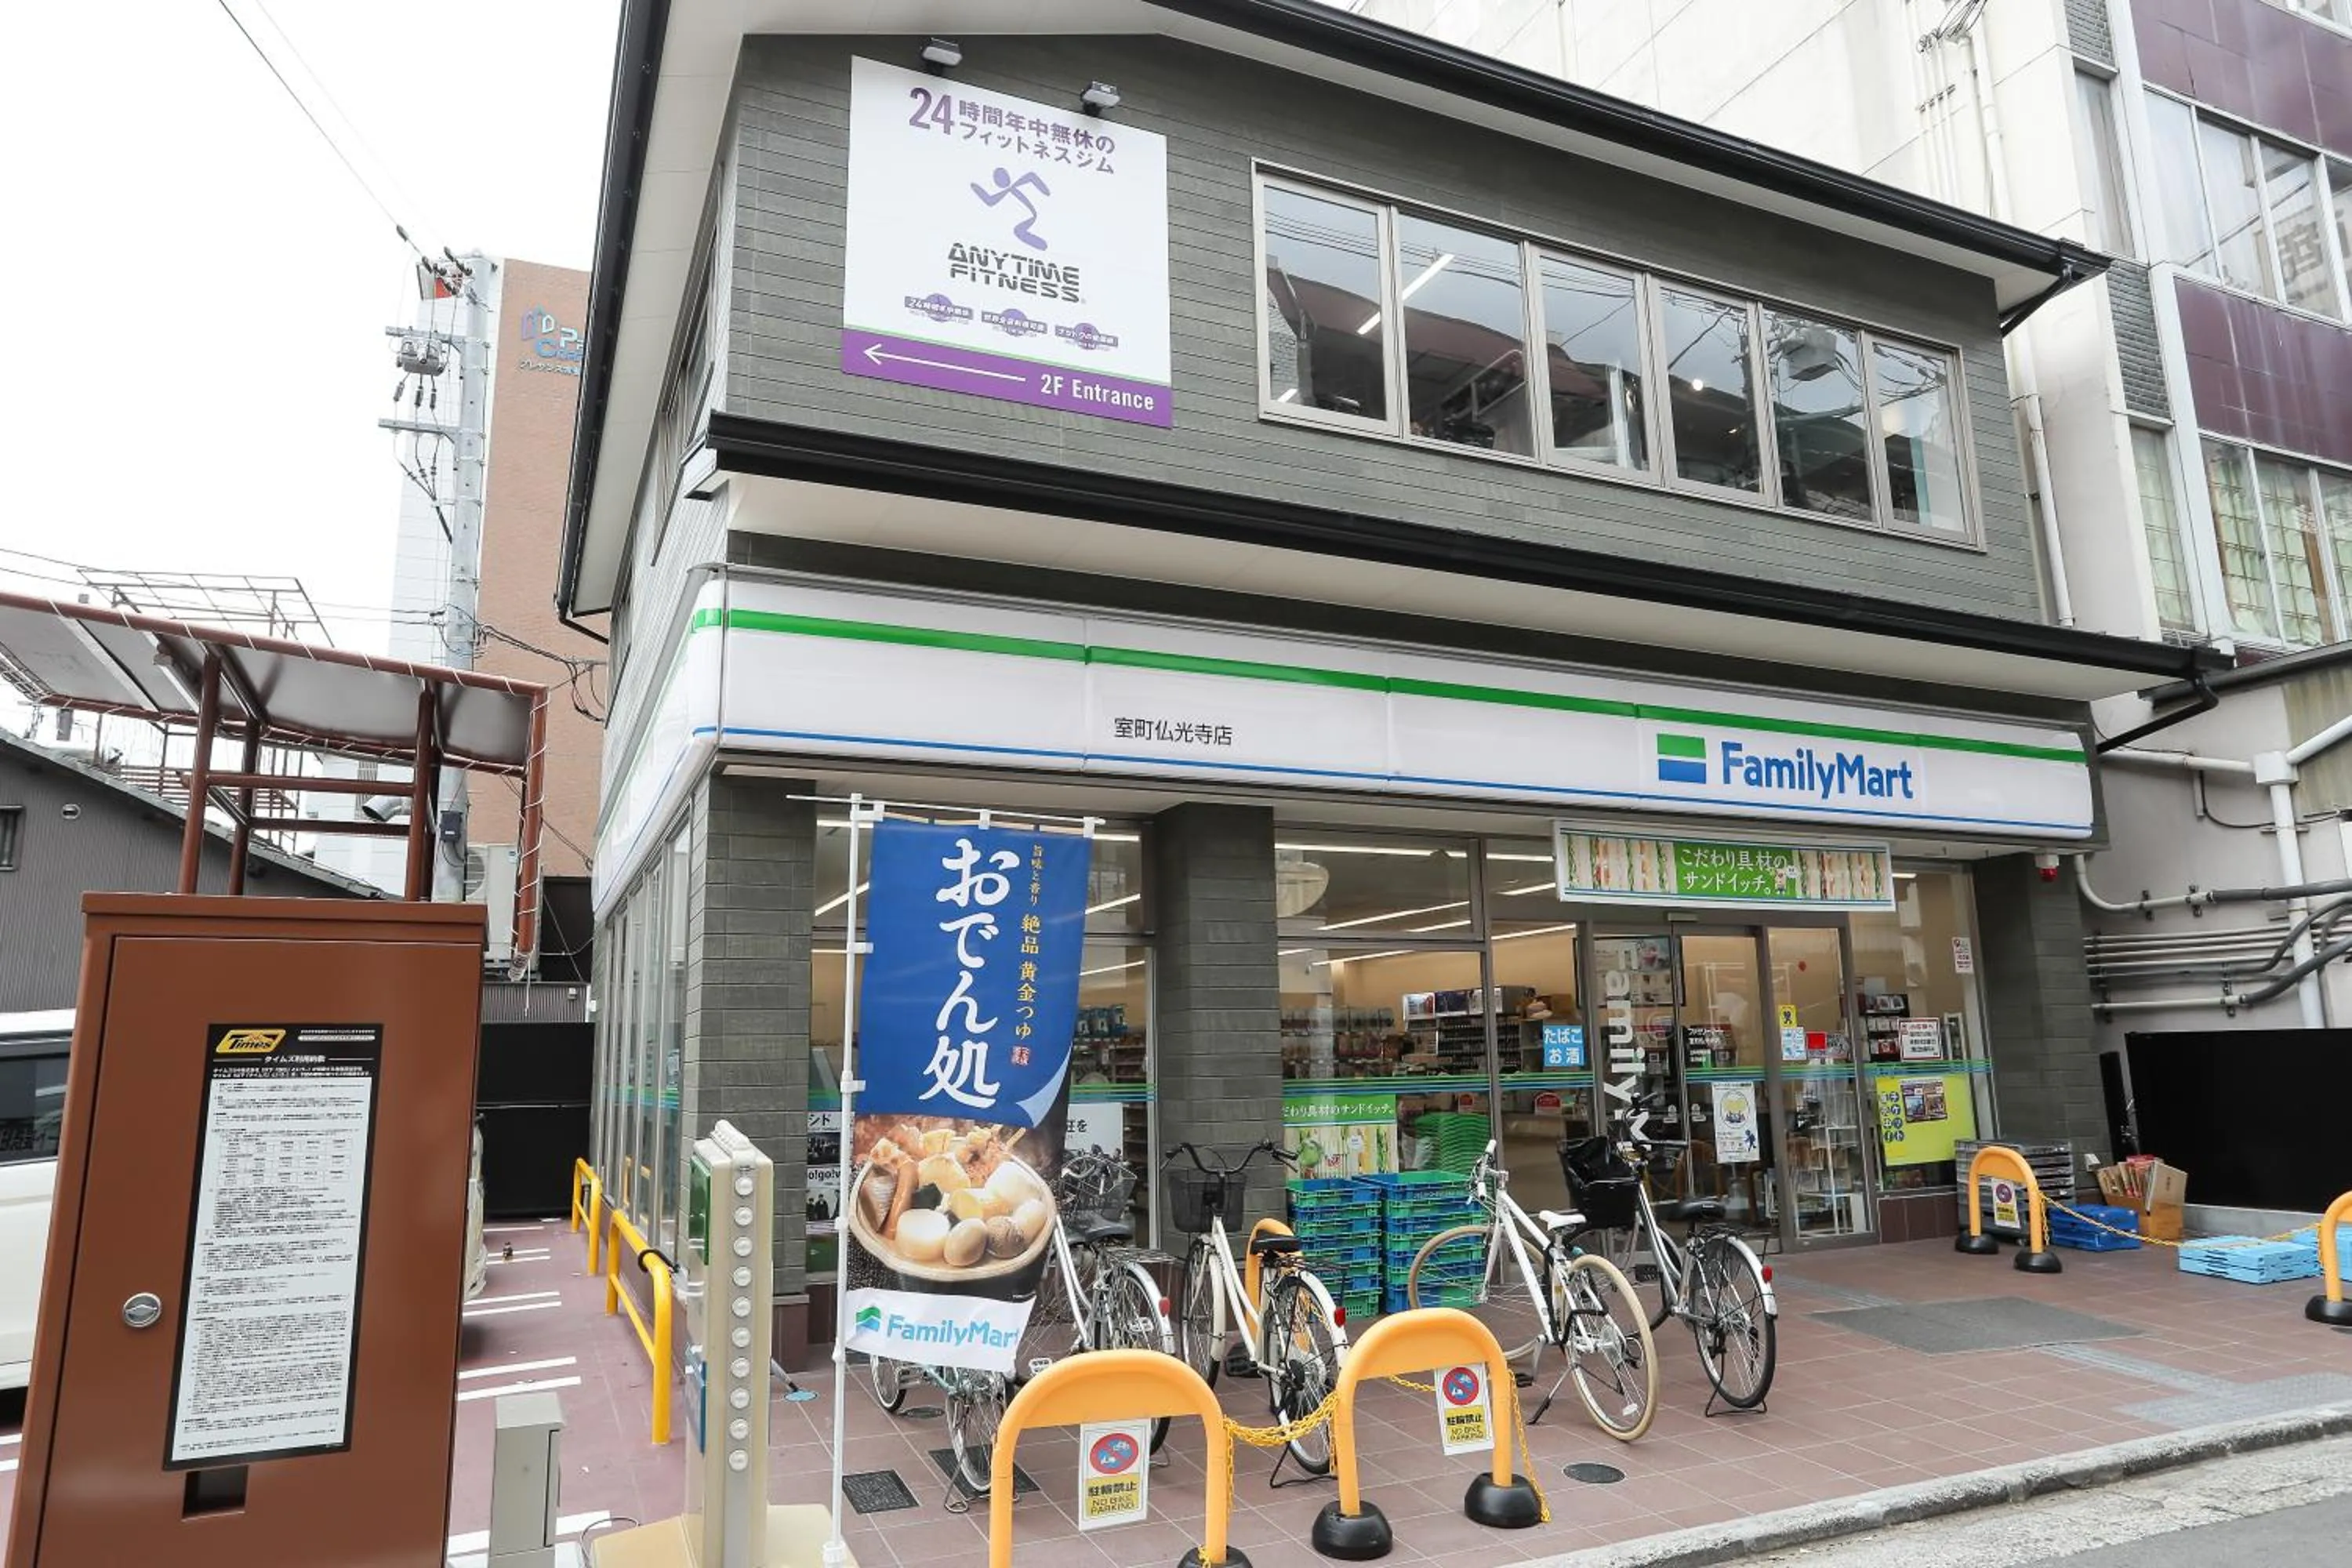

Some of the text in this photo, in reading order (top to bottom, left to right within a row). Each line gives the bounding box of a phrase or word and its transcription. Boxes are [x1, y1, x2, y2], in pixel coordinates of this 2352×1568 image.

[909, 87, 1116, 154] 24 時間年中無休の
[960, 122, 1115, 174] フィットネスジム
[948, 241, 1080, 286] ANYTIME
[949, 263, 1080, 303] FITNESS
[1040, 374, 1155, 411] 2F Entrance
[1113, 717, 1232, 746] 室町仏光寺店
[1721, 741, 1914, 799] FamilyMart
[1680, 847, 1787, 871] こだわり具材の
[1021, 913, 1041, 954] 絶品
[918, 838, 1020, 1109] おでん処
[1015, 960, 1037, 1040] 黄金つゆ
[229, 1034, 272, 1049] Times
[1544, 1028, 1583, 1044] たばこ
[1548, 1047, 1580, 1064] お酒
[1088, 1481, 1138, 1496] 駐輪禁止
[1110, 1493, 1132, 1504] BIKE
[1091, 1501, 1135, 1515] PARKING
